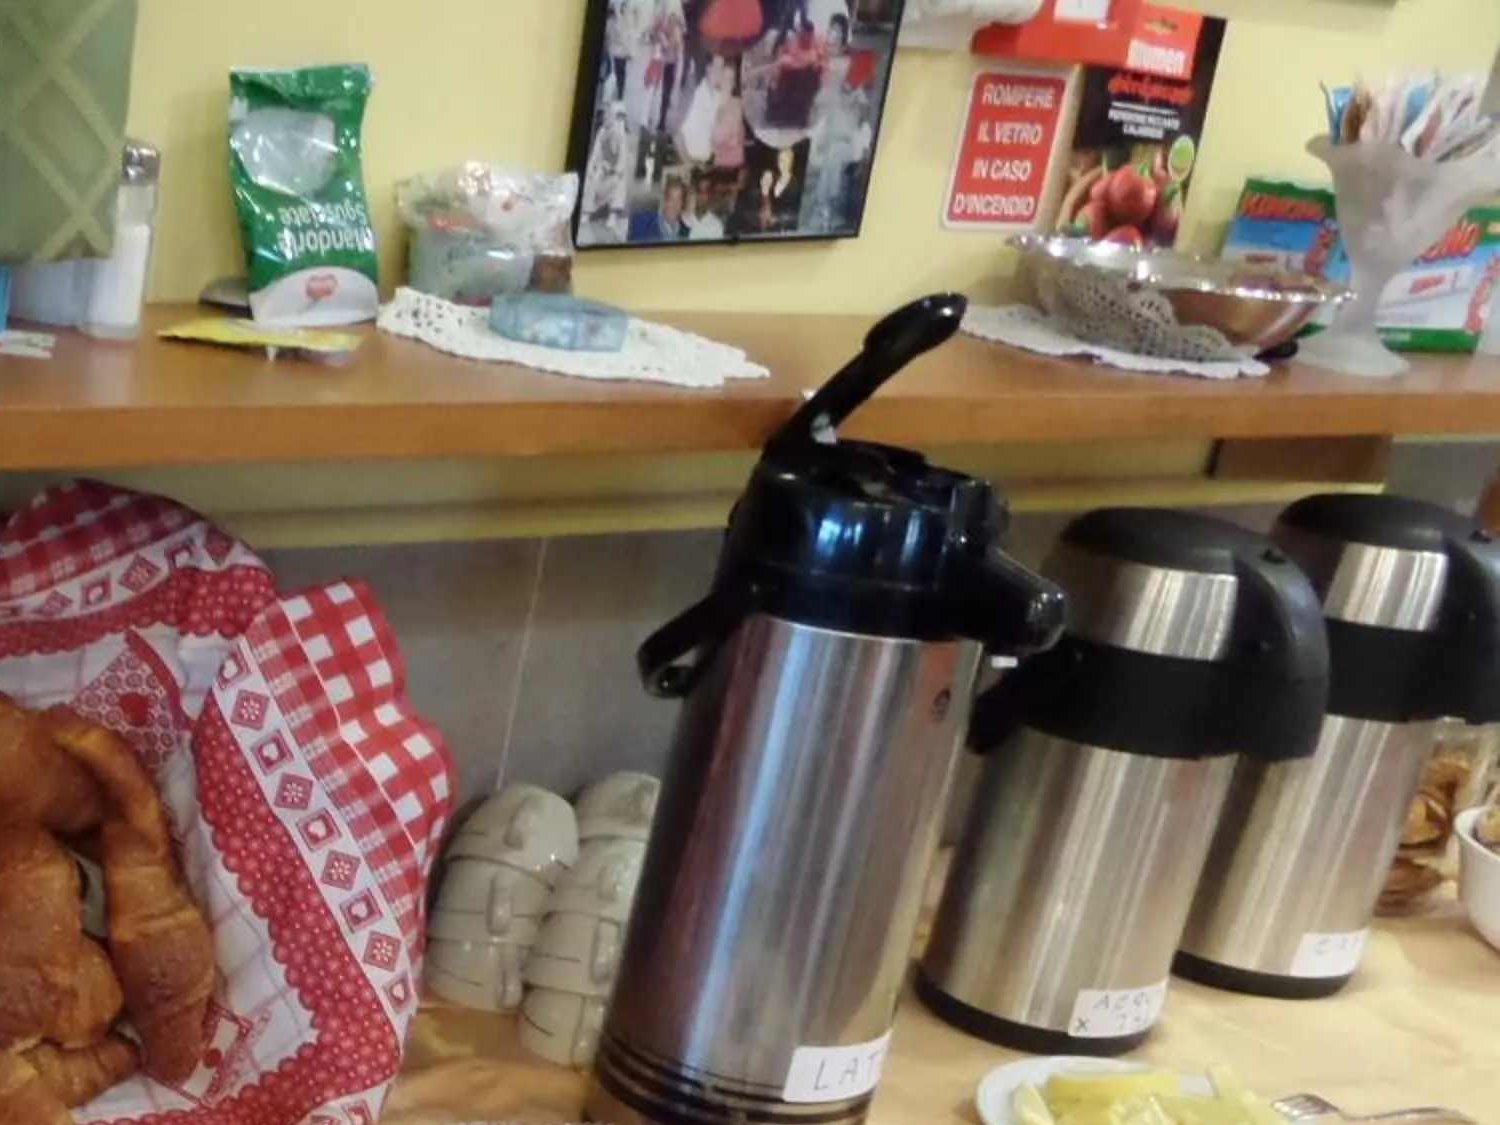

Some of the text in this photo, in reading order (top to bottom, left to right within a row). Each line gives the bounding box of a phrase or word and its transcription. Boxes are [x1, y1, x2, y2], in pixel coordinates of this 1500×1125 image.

[982, 83, 1056, 110] ROMPERE
[977, 120, 1043, 145] IL VETRO
[971, 156, 1033, 182] IN CASO
[952, 193, 1035, 217] D'INCENDIO
